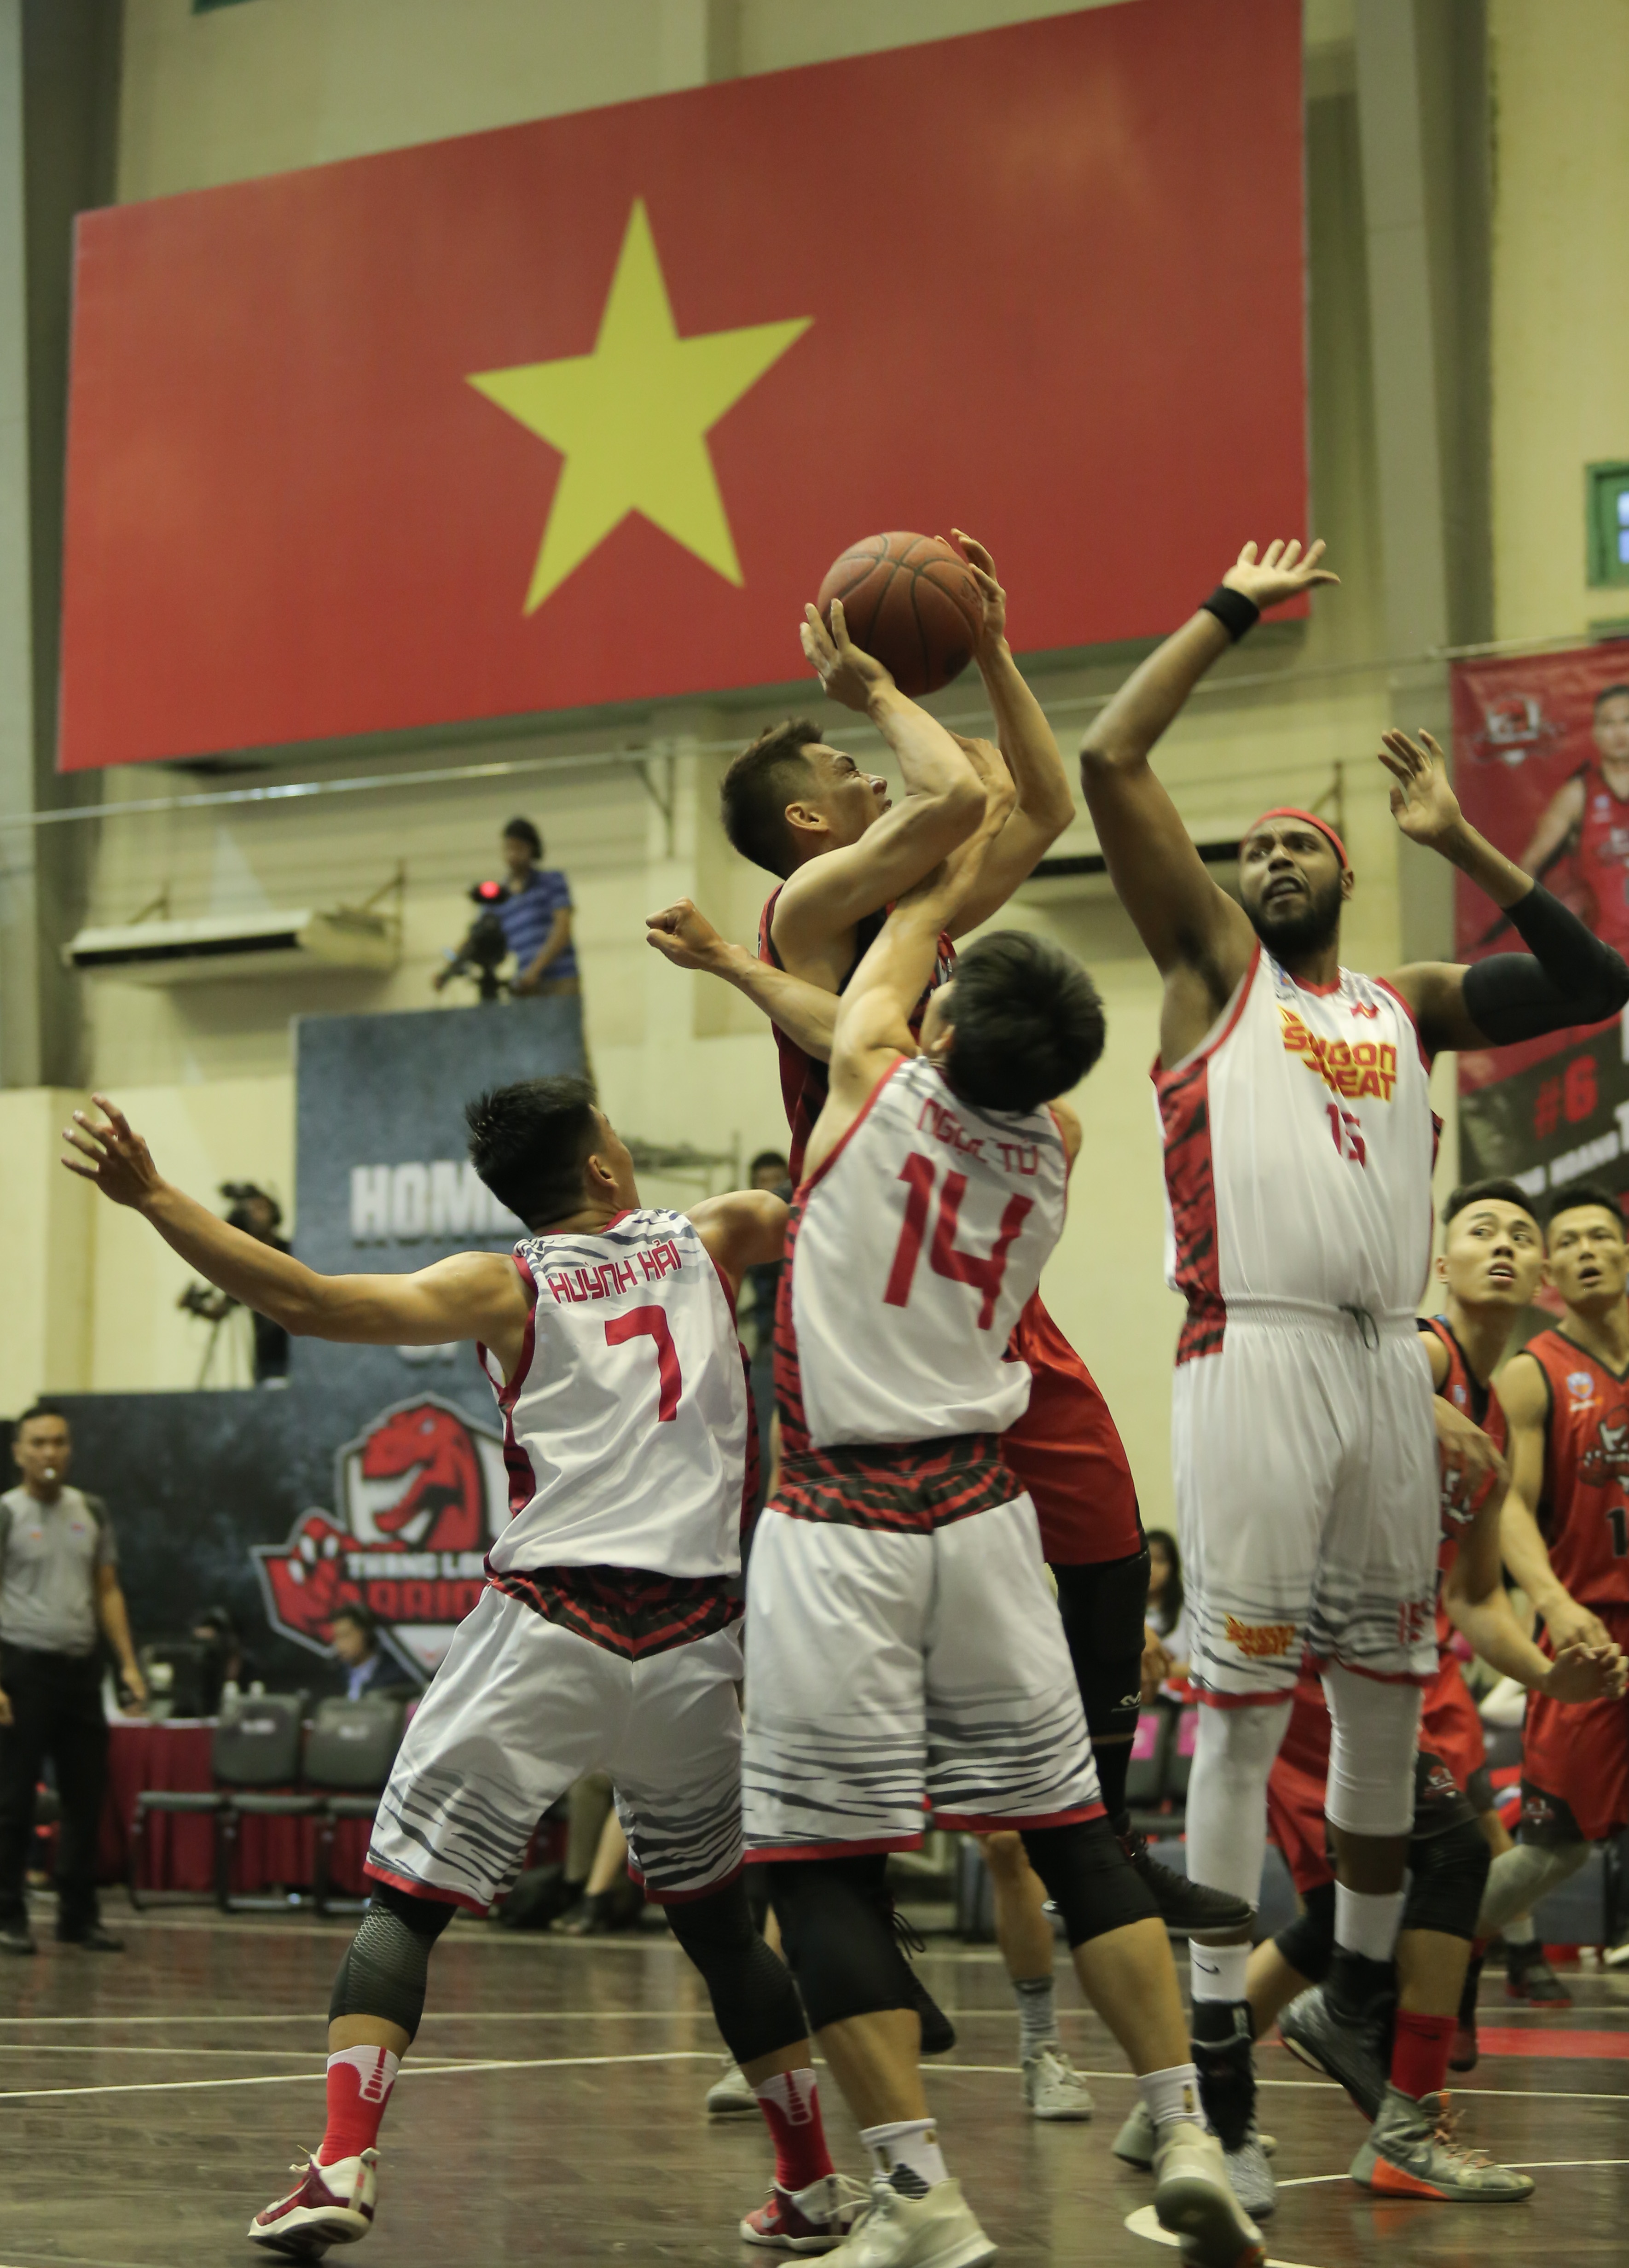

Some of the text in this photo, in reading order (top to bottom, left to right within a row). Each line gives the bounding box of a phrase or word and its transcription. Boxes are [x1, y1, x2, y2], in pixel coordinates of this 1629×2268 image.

[637, 1239, 682, 1281] HẢI
[882, 1151, 1034, 1331] 14
[604, 1305, 682, 1422] 7
